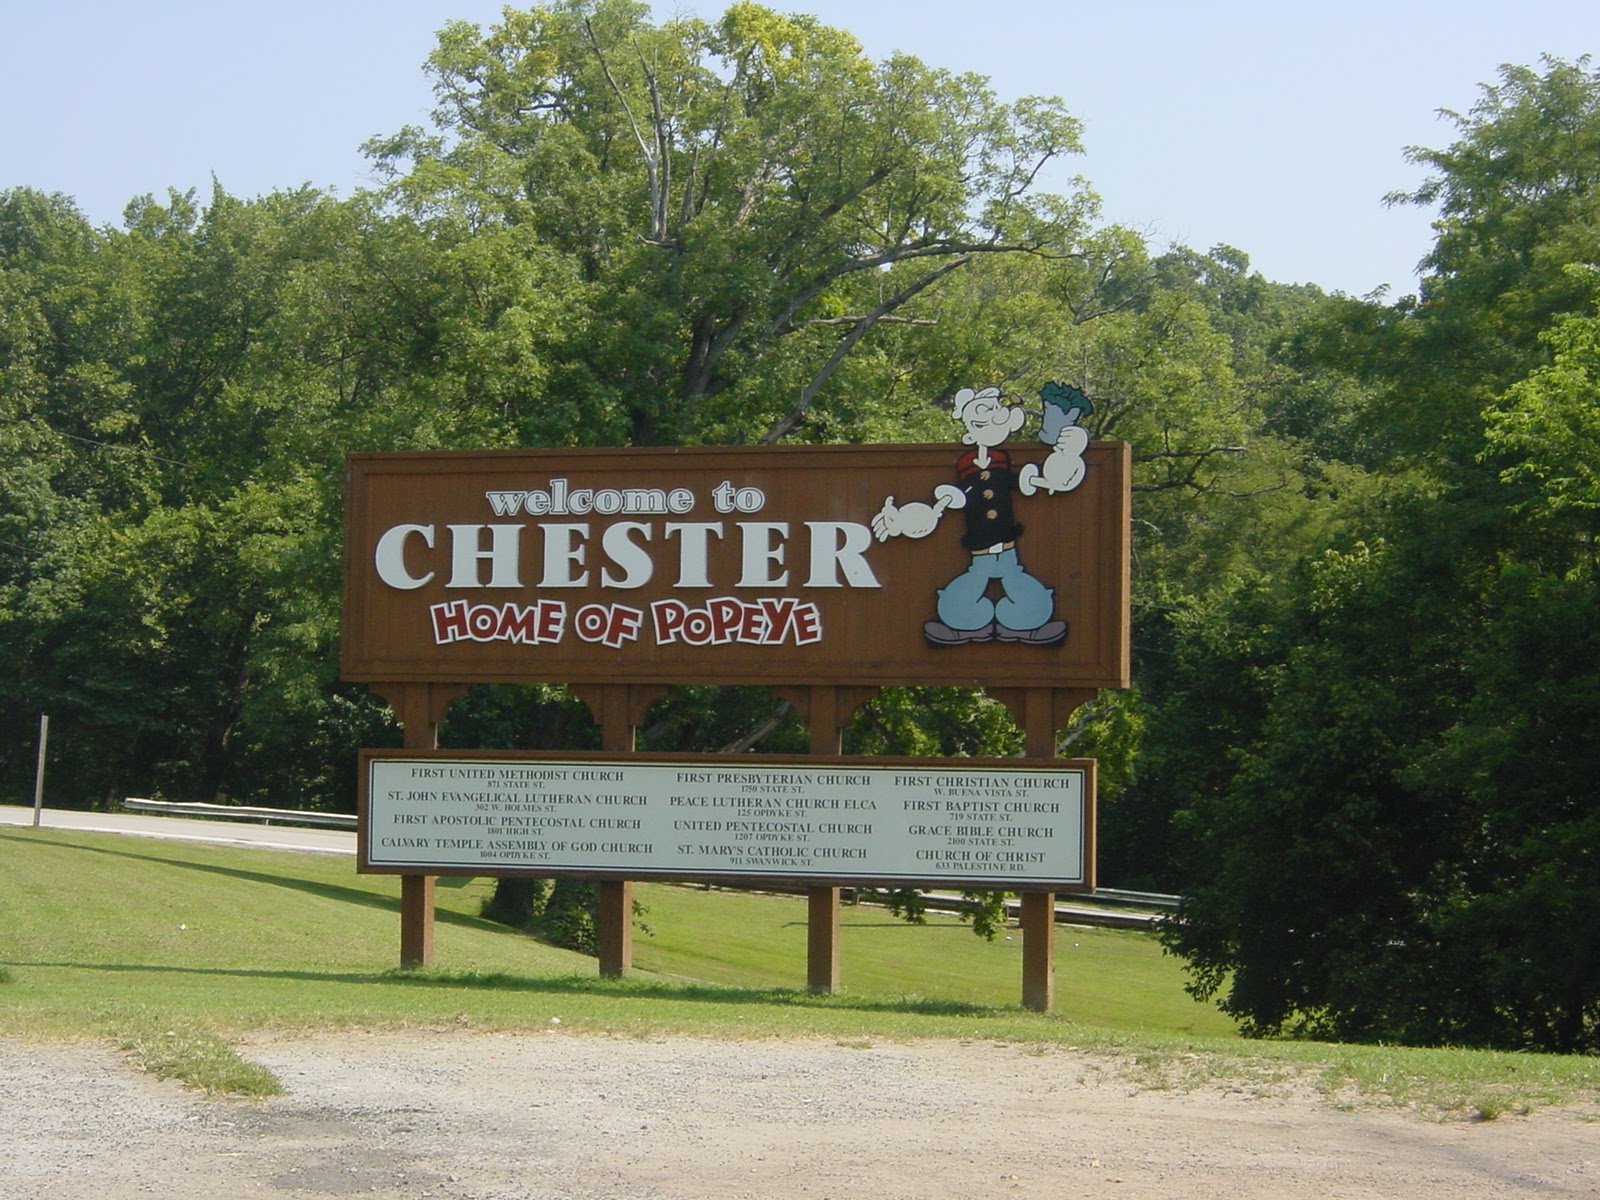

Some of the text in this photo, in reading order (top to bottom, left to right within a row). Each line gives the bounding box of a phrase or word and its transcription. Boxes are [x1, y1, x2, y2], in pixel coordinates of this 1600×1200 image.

[486, 479, 765, 517] welcome to
[375, 521, 882, 590] CHESTER
[430, 597, 823, 648] HOME OF POPEYE
[411, 769, 624, 781] FIRST UNITED METHODIST CHURCH
[677, 773, 871, 785] FIRST PRESBYTERIAN CHURCH
[894, 777, 1070, 788] FIRST CHRISTIAN CHURCH
[387, 791, 647, 805] ST. JOHN EVANGELICAL LUTHERAN CHURCH
[934, 788, 946, 796] W.
[985, 789, 1012, 797] VISTA
[504, 804, 542, 812] HOLMES
[670, 797, 877, 809] PEACE LUTHERAN CHURCH ELCA
[903, 801, 1059, 813] FIRST BAPTIST CHURCH
[754, 809, 790, 817] OPDYKE
[999, 814, 1012, 822] ST.
[393, 815, 641, 829] FIRST APOSTOLIC PENTECOSTAL CHURCH
[673, 821, 872, 834] UNITED PENTECOSTAL CHURCH
[908, 825, 1053, 837] GRACE BIBLE CHURCH
[796, 834, 810, 842] ST.
[968, 838, 997, 846] STATE
[381, 838, 653, 853] CALVARY TEMPLE ASSEMBLY OF GOD CHURCH
[678, 845, 867, 858] ST. MARY'S CATHOLIC CHURCH
[538, 852, 550, 860] ST.
[730, 857, 743, 865] 911
[746, 858, 797, 866] SWANWICK
[916, 850, 1045, 862] CHURCH OF CHRIST
[953, 863, 1006, 871] PALESTINE
